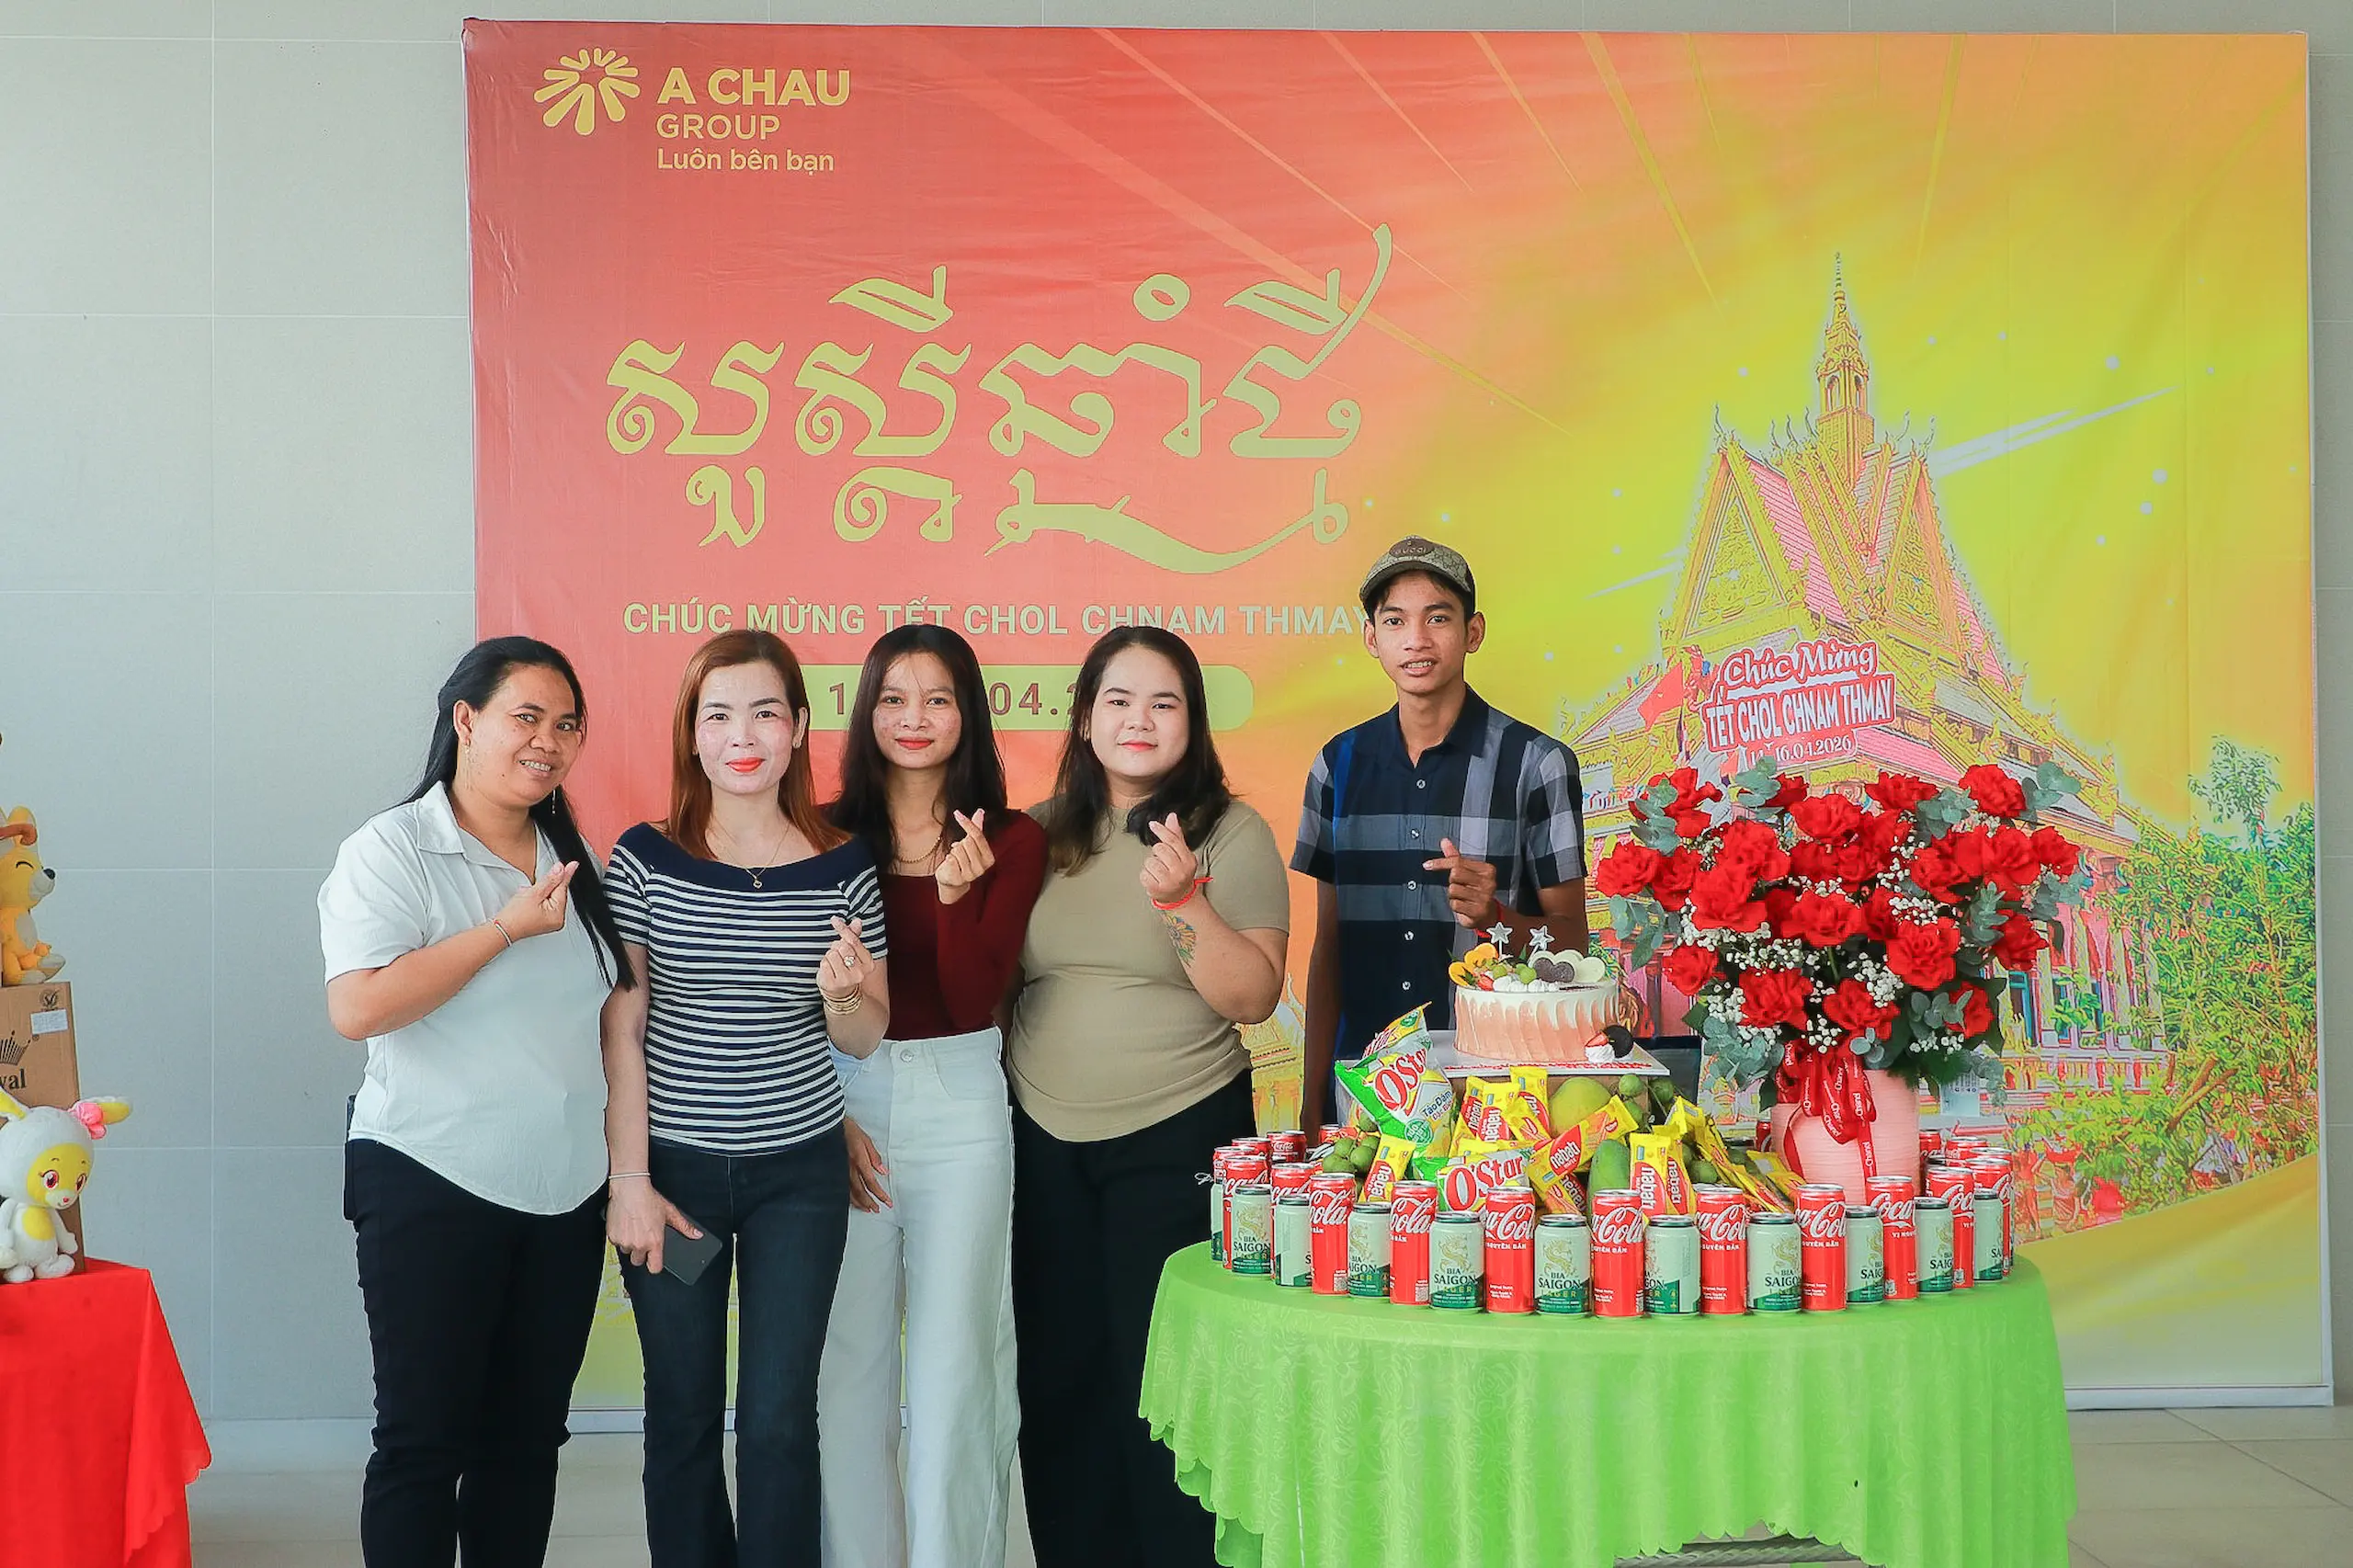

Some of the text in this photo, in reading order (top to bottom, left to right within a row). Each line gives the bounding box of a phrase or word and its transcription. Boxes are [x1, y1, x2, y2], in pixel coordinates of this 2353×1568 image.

[656, 67, 851, 107] A CHAU
[655, 113, 781, 141] GROUP
[656, 148, 835, 176] Luôn bên bạn
[622, 597, 733, 635] CHÚC
[745, 596, 867, 635] MỪNG
[876, 595, 952, 631] TẾT
[962, 603, 1069, 636] CHOL
[1080, 603, 1226, 636] CHNAM
[1724, 642, 1874, 686] Chúc Mừng
[1705, 678, 1892, 748] TẾT CHOL CHNAM THMAY
[1775, 734, 1852, 762] 16.04.2026
[1445, 1155, 1524, 1212] O'Star
[1233, 1241, 1271, 1253] SAIGON
[1859, 1268, 1883, 1279] SAIG
[1929, 1258, 1953, 1269] SAIG
[1433, 1273, 1476, 1285] SAIGON
[1538, 1278, 1582, 1290] SAIGON
[1764, 1276, 1801, 1288] SAIGO
